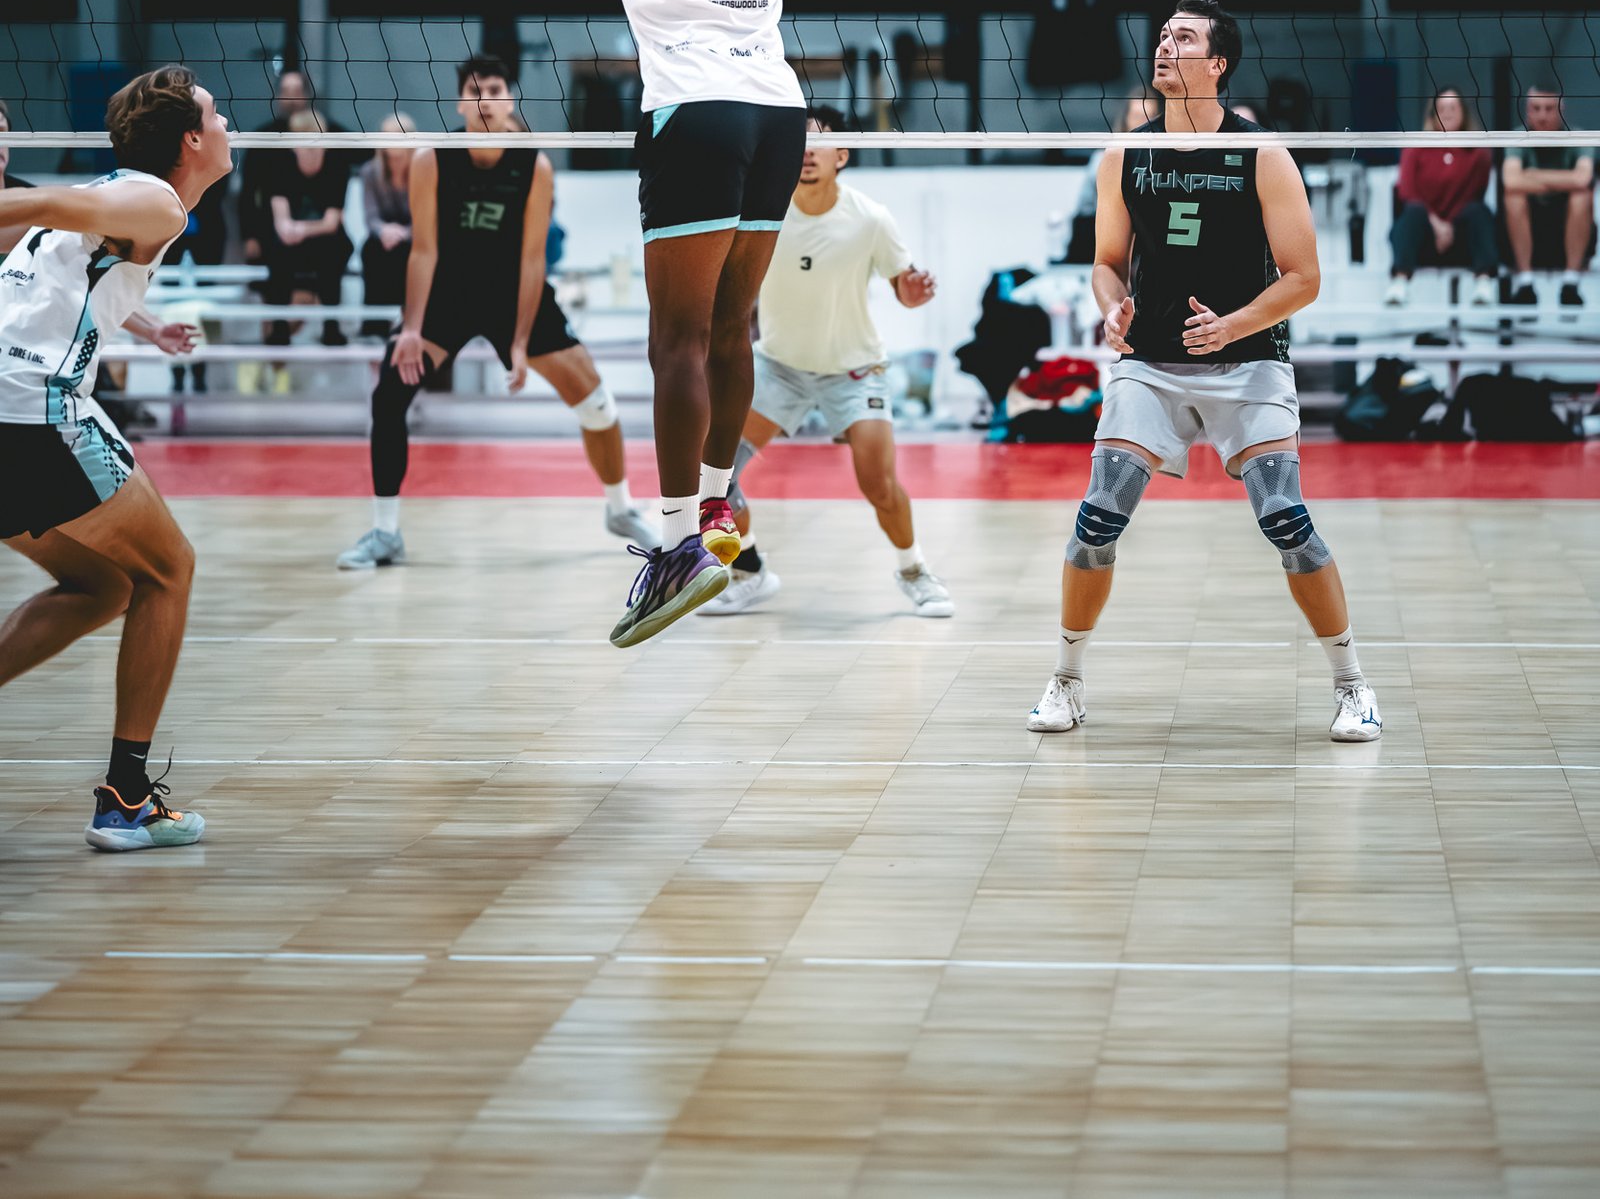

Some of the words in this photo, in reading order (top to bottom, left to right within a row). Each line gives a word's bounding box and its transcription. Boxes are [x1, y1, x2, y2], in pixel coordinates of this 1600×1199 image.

[460, 202, 506, 230] 12
[1166, 202, 1202, 246] 5
[800, 256, 812, 271] 3
[8, 346, 27, 360] CORE
